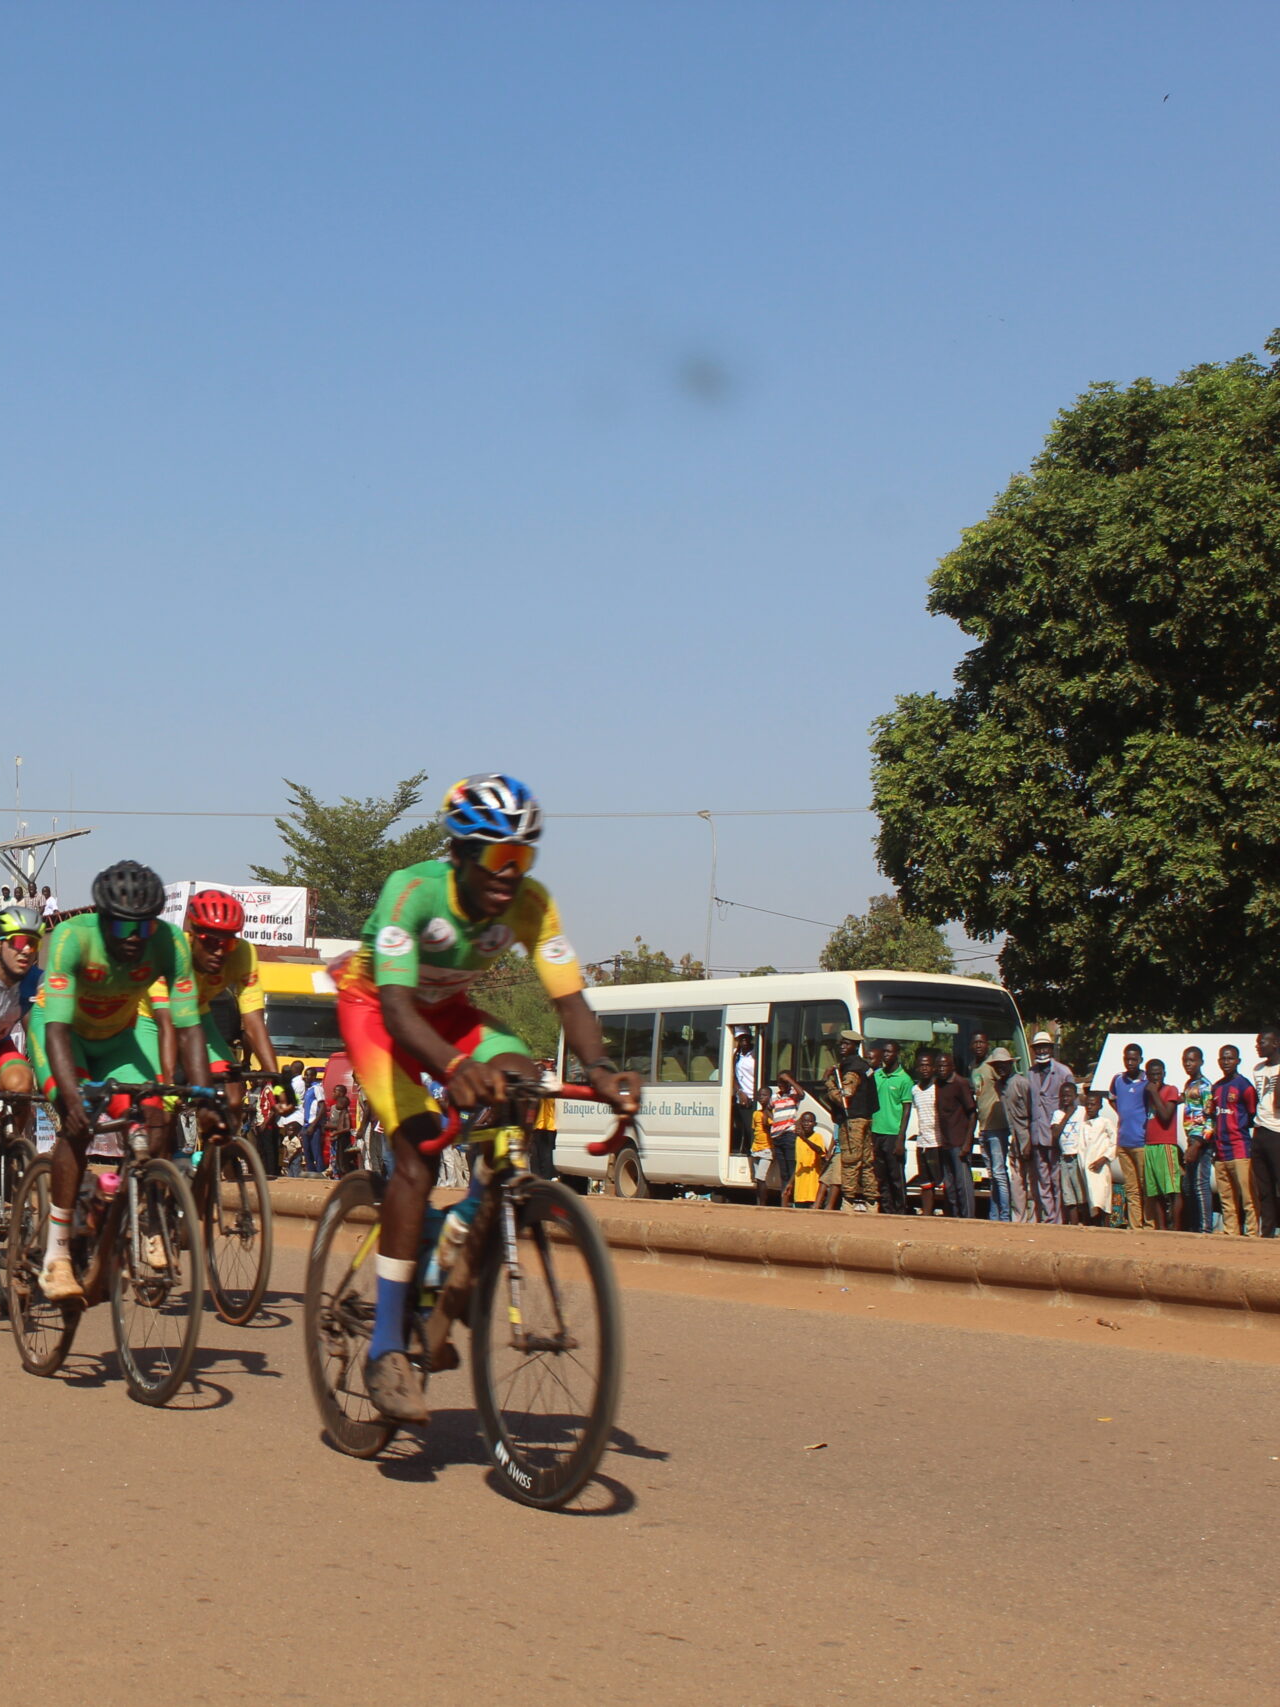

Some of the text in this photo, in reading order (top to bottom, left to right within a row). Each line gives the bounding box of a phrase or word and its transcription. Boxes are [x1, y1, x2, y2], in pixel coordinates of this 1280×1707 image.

[260, 914, 293, 925] Officiel
[260, 931, 271, 940] du
[273, 930, 293, 941] Faso
[563, 1101, 595, 1117] Banque
[659, 1102, 671, 1116] du
[674, 1101, 715, 1117] Burkina
[507, 1461, 533, 1489] SWISS
